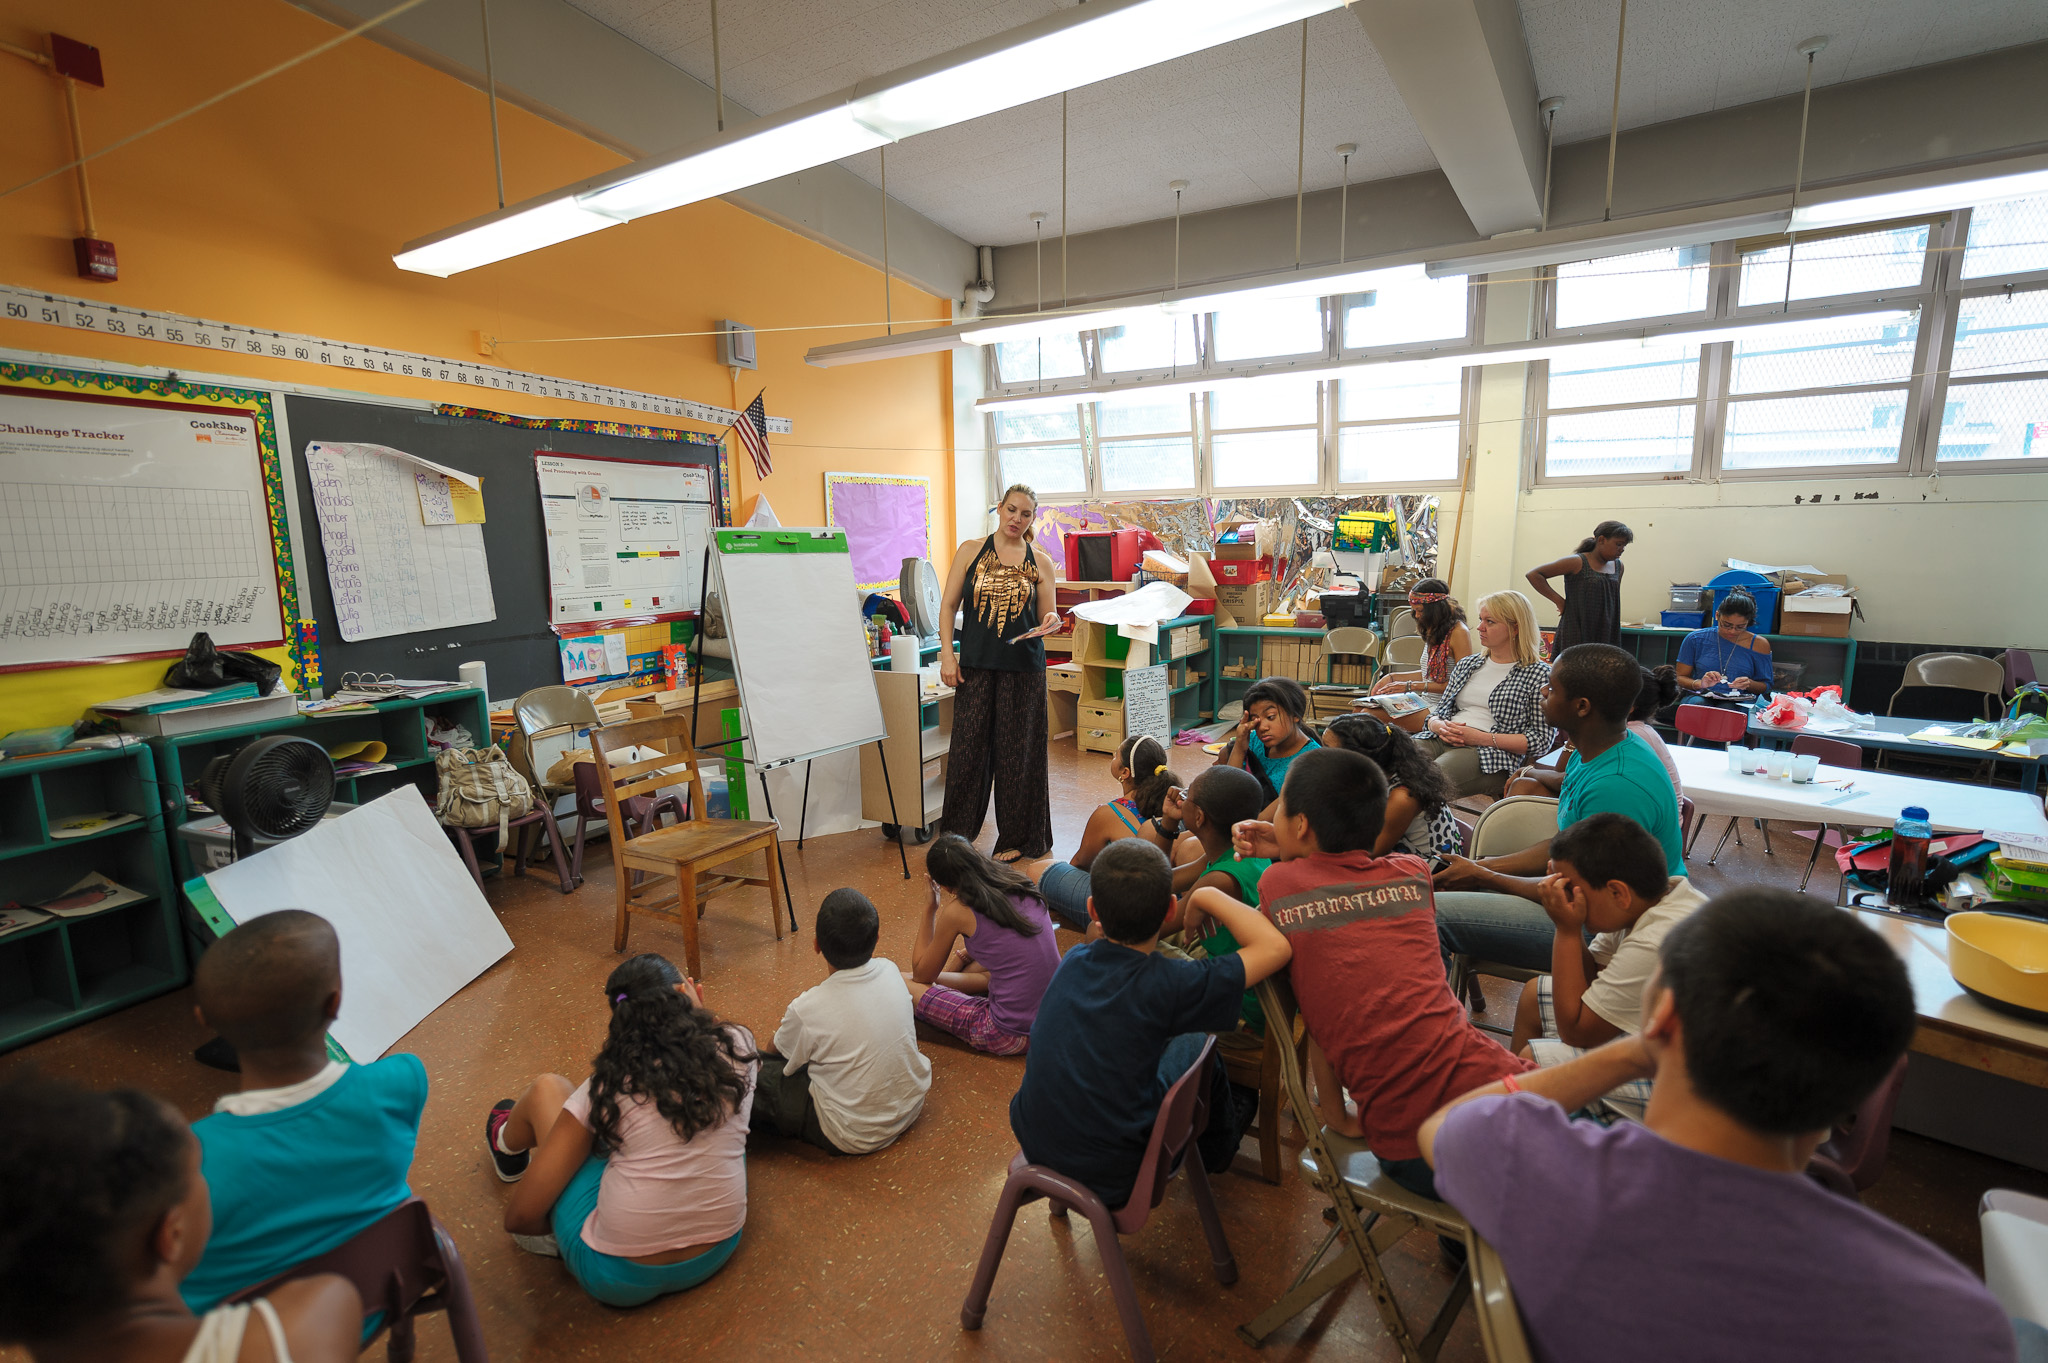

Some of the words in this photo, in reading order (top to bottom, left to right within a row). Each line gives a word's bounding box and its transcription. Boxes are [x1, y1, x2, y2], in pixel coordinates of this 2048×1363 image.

[95, 255, 115, 265] FIRE
[7, 302, 28, 318] 50
[41, 308, 60, 323] 51
[75, 313, 96, 329] 52
[107, 318, 126, 334] 53
[137, 323, 155, 338] 54
[166, 328, 184, 342] 55
[194, 332, 211, 346] 56
[221, 336, 236, 349] 57
[246, 340, 262, 353] 58
[271, 343, 286, 356] 59
[295, 347, 309, 360] 60
[321, 352, 332, 364] 61
[343, 355, 356, 367] 62
[363, 358, 375, 370] 63
[382, 361, 394, 372] 64
[402, 364, 413, 375] 65
[421, 367, 432, 378] 66
[440, 369, 450, 380] 67
[457, 372, 467, 383] 68
[474, 375, 485, 385] 69
[491, 377, 500, 388] 70
[506, 380, 514, 390] 71
[521, 382, 530, 392] 72
[539, 385, 547, 396] 73
[554, 388, 562, 398] 74
[567, 390, 575, 400] 75
[580, 392, 588, 402] 76
[593, 394, 601, 403] 77
[606, 396, 614, 406] 78
[619, 398, 626, 407] 79
[631, 400, 638, 409] 80
[642, 402, 649, 411] 81
[653, 404, 660, 413] 82
[664, 406, 671, 414] 83
[675, 407, 682, 416] 84
[686, 409, 694, 418] 85
[697, 411, 703, 420] 86
[706, 413, 713, 422] 87
[717, 415, 723, 424] 88
[727, 418, 734, 426] 89
[0, 423, 69, 439] Challenge
[72, 429, 125, 441] Tracker
[190, 420, 247, 435] CookShop
[308, 453, 335, 472] Ernie
[313, 470, 343, 489] Jaden
[313, 487, 354, 507] Nicholas
[319, 505, 348, 524] Amber
[323, 522, 348, 547] Angel
[324, 538, 356, 562] Crystal
[327, 556, 360, 574] Brianna
[330, 572, 362, 590] Victoria
[333, 588, 362, 606] Leilani
[22, 606, 46, 638] Crystal
[140, 606, 156, 631] Shane
[199, 600, 214, 627] Joshua
[338, 604, 360, 622] Julia
[1275, 884, 1422, 928] INTERNATIONAL
